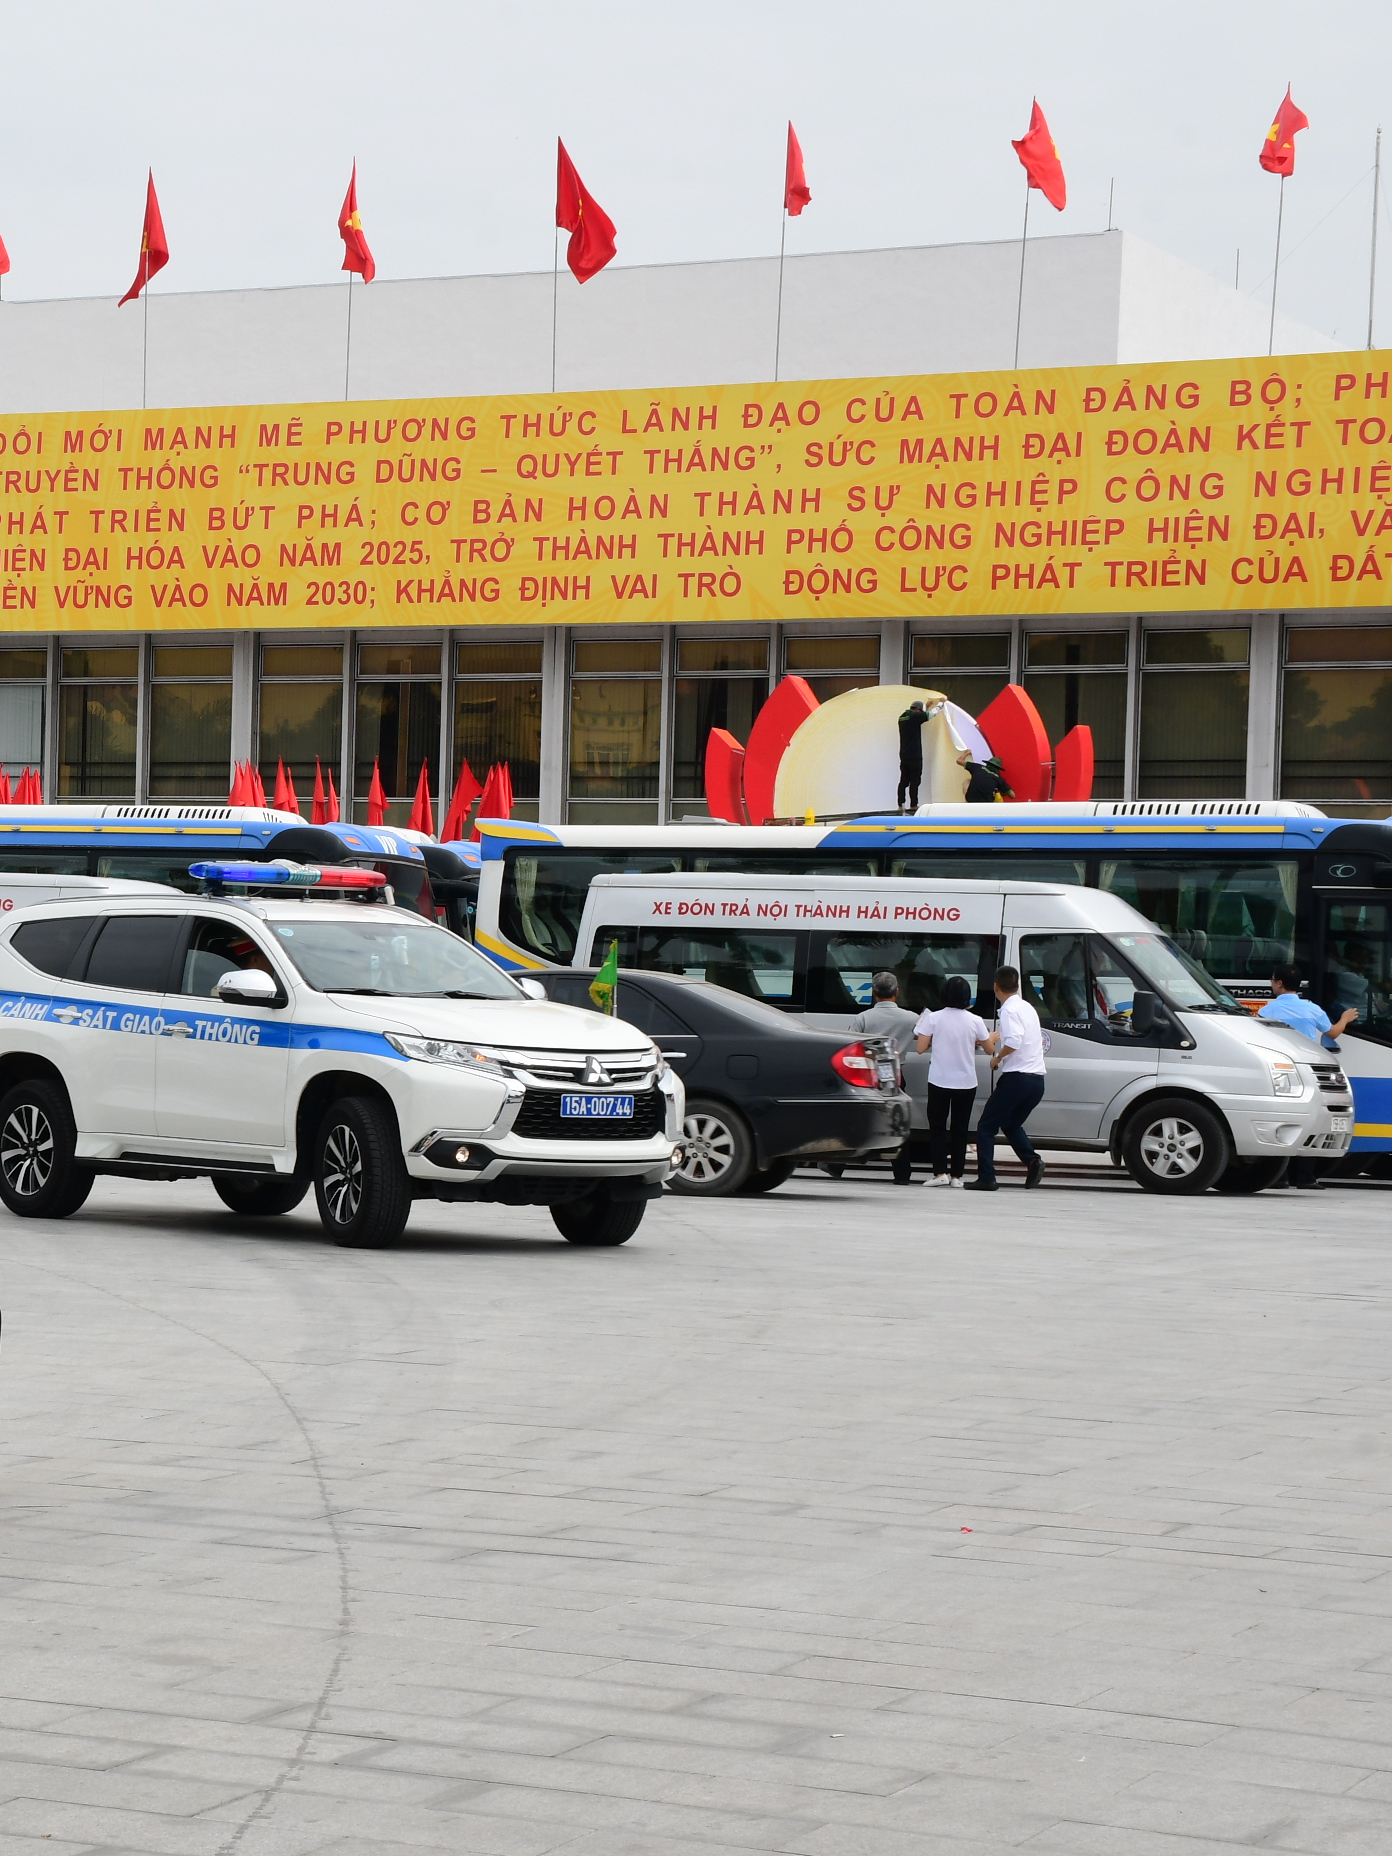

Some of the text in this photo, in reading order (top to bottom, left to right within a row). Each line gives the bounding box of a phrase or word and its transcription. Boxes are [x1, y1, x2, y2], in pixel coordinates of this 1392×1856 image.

[63, 422, 123, 454] MỚI
[143, 425, 237, 456] MẠNH
[258, 416, 304, 448] MẼ
[325, 414, 476, 445] PHƯƠNG
[499, 405, 597, 439] THỨC
[621, 401, 718, 434] LÃNH
[741, 401, 821, 434] ĐẠO
[845, 390, 924, 424] CỦA
[948, 383, 1056, 419] TOÀN
[1082, 378, 1200, 414] ĐẢNG
[1229, 372, 1303, 412] BỘ;
[117, 454, 219, 491] THỐNG
[238, 461, 356, 487] “TRUNG
[375, 453, 462, 484] DŨNG
[516, 444, 624, 480] QUYẾT
[643, 440, 782, 475] THẮNG”,
[804, 433, 877, 468] SỨC
[899, 434, 1000, 468] MẠNH
[1021, 431, 1083, 466] ĐẠI
[1104, 419, 1212, 457] ĐOÀN
[1236, 413, 1312, 451] KẾT
[1335, 416, 1392, 446] TO
[89, 500, 186, 534] TRIỂN
[207, 497, 276, 531] BỨT
[297, 496, 377, 530] PHÁ;
[400, 500, 451, 527] CƠ
[472, 492, 543, 525] BẢN
[567, 487, 669, 522] HOÀN
[693, 483, 821, 518] THÀNH
[846, 484, 901, 519] SỰ
[925, 471, 1079, 513] NGHIỆP
[1105, 468, 1224, 504] CÔNG
[62, 547, 109, 578] ĐẠI
[126, 539, 186, 572] HÓA
[201, 537, 261, 570] VÀO
[279, 537, 342, 568] NĂM
[359, 540, 431, 567] 2025,
[449, 532, 515, 565] TRỞ
[532, 529, 637, 563] THÀNH
[657, 525, 765, 559] THÀNH
[785, 521, 854, 556] PHỐ
[874, 518, 972, 553] CÔNG
[994, 514, 1125, 553] NGHIỆP
[1147, 509, 1230, 549] HIỆN
[1252, 512, 1325, 547] ĐẠI,
[53, 578, 133, 610] VỮNG
[149, 575, 209, 608] VÀO
[226, 575, 288, 608] NĂM
[305, 580, 376, 609] 2030;
[395, 571, 501, 605] KHẲNG
[518, 575, 591, 608] ĐỊNH
[610, 574, 658, 601] VAI
[677, 565, 742, 599] TRÒ
[782, 562, 878, 603] ĐỘNG
[900, 563, 969, 599] LỰC
[991, 555, 1083, 591] PHÁT
[1103, 551, 1207, 588] TRIỂN
[1230, 549, 1309, 585] CỦA
[652, 897, 961, 923] XE ĐÓN TRẢ NỘI THÀNH HẢI PHÒNG
[1229, 988, 1272, 997] THACO
[78, 1007, 116, 1031] SÁT
[119, 1012, 165, 1035] GIAO
[194, 1018, 261, 1045] THÔNG
[565, 1096, 632, 1116] 15A-007.44
